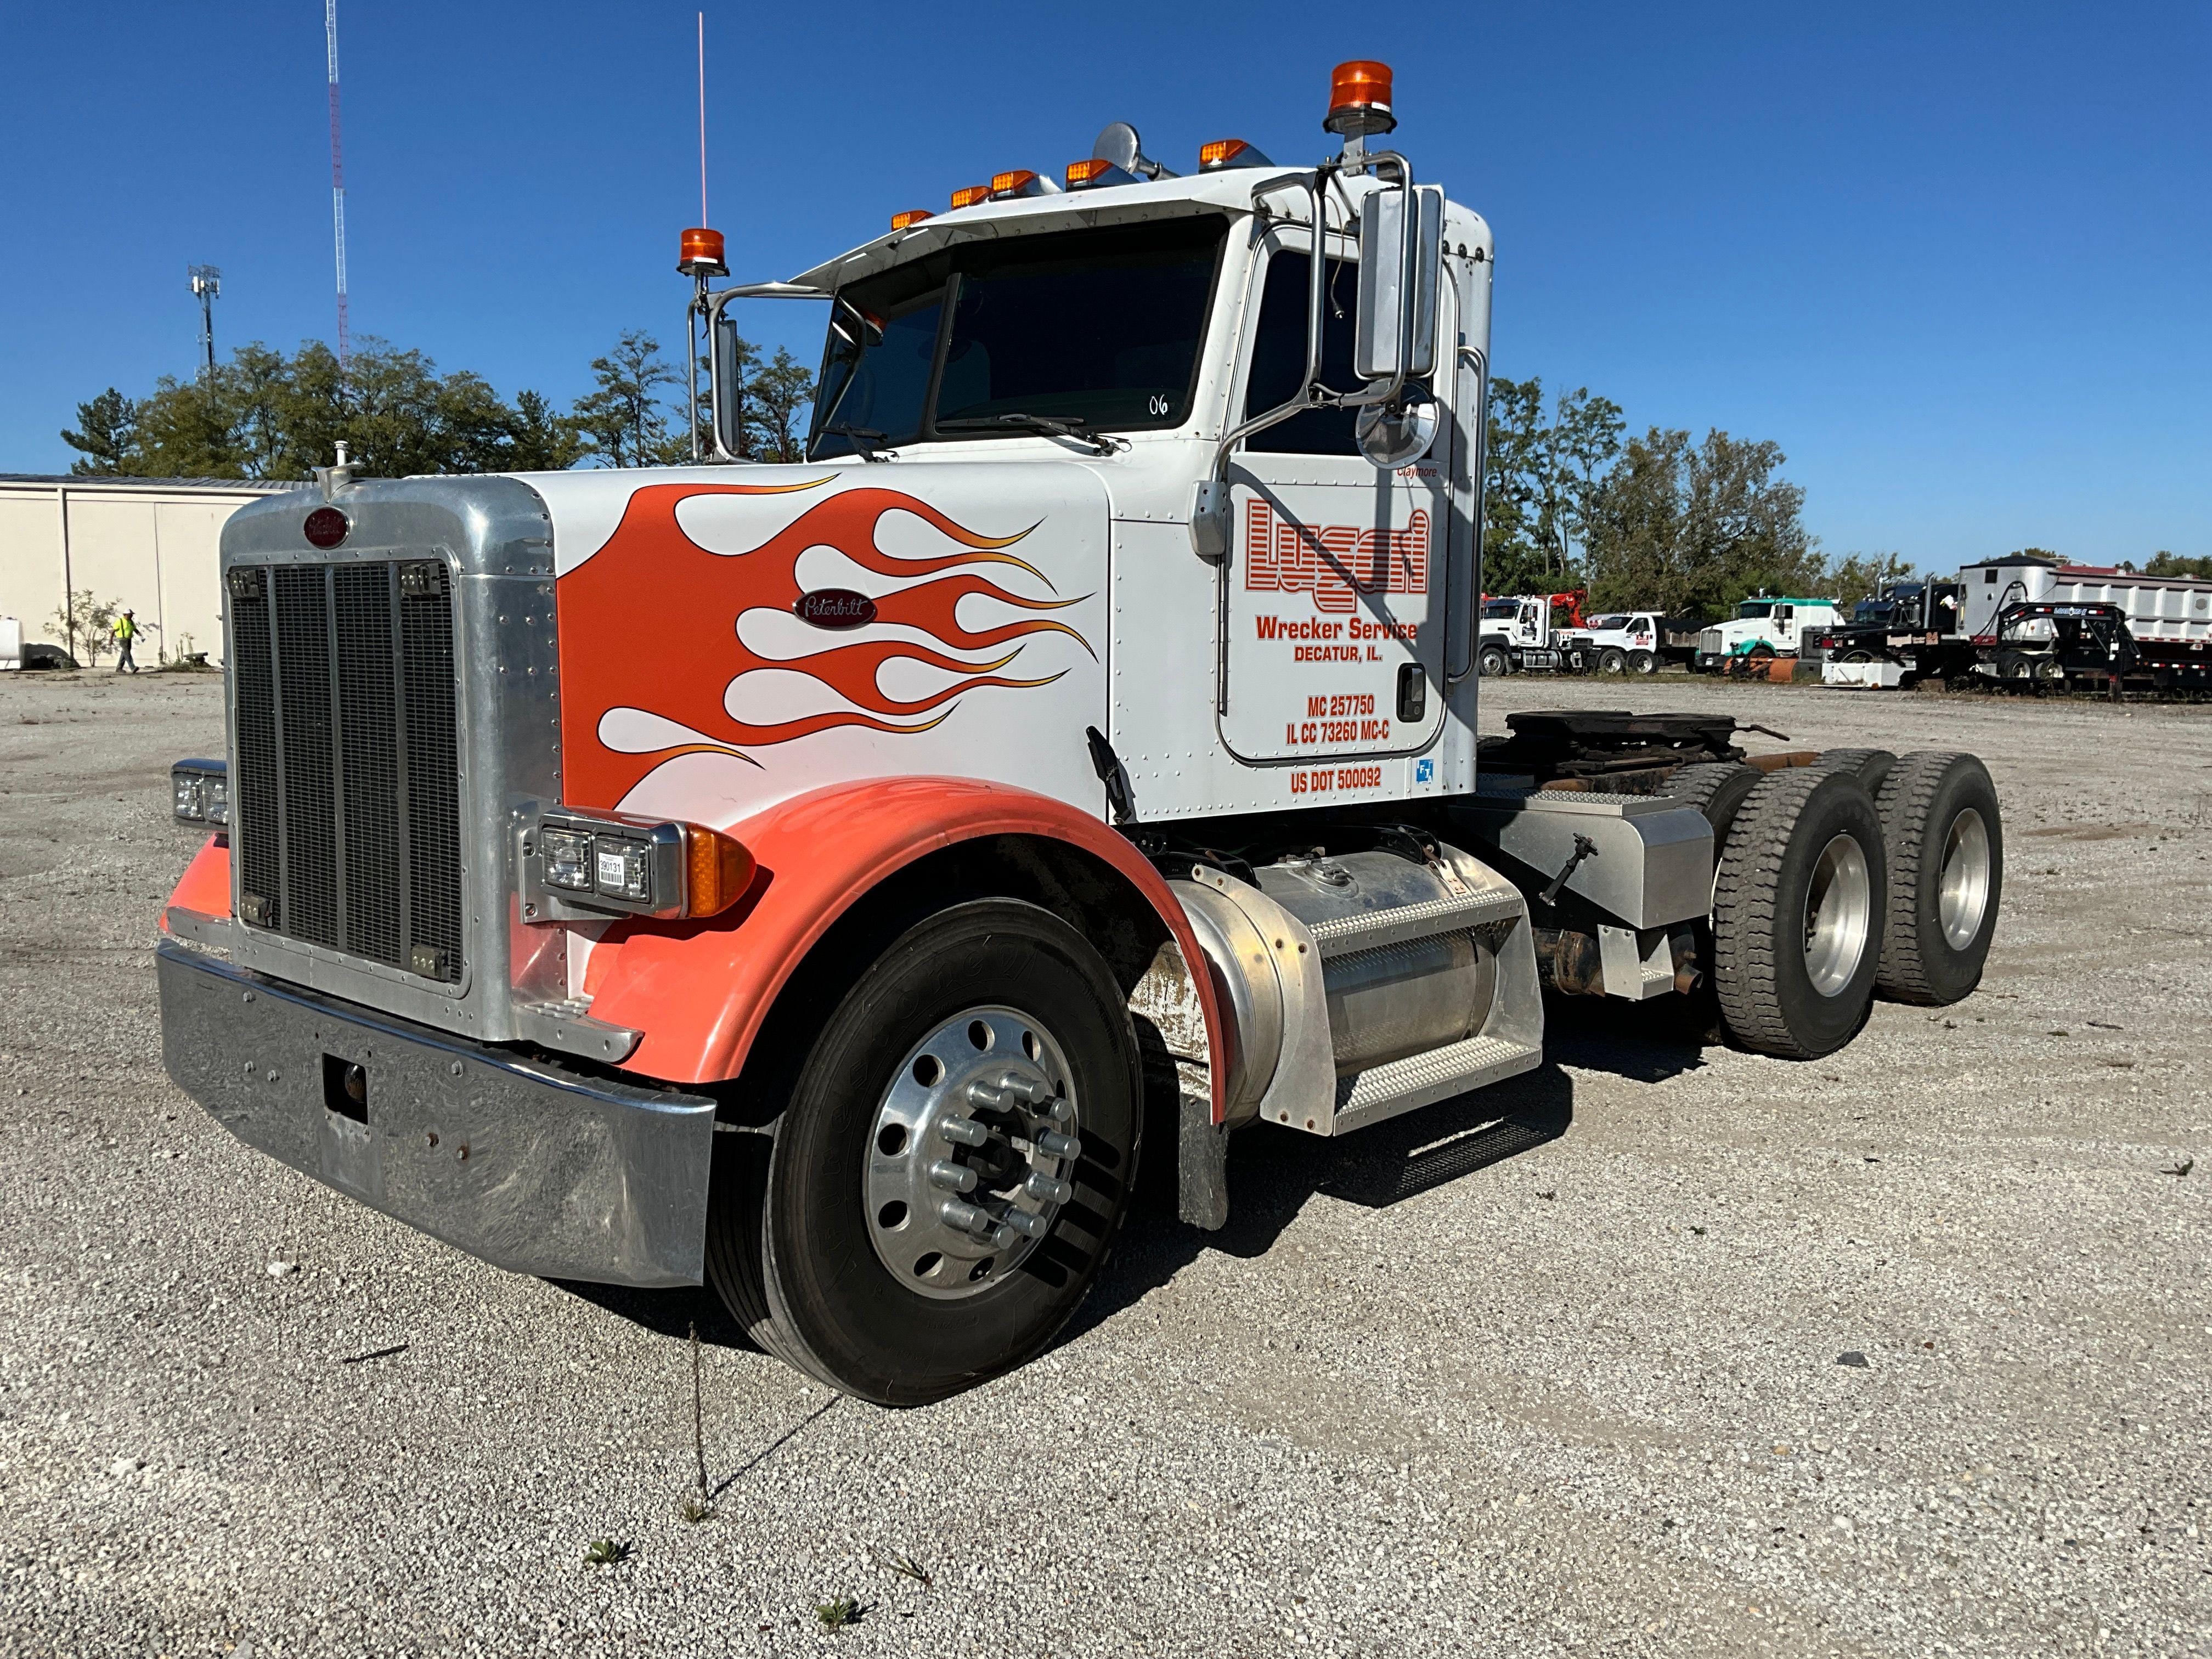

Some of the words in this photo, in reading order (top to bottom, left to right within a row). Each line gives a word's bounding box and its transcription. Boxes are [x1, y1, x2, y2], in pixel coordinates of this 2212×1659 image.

[1149, 394, 1168, 415] 06
[1397, 467, 1437, 479] Claymore
[804, 595, 868, 617] Peterbilt
[1255, 616, 1343, 640] Wrecker
[1348, 616, 1418, 640] Service
[1294, 646, 1362, 663] DECATUR,
[1367, 646, 1383, 661] IL.
[1307, 696, 1327, 718] MC
[1330, 693, 1374, 716] 257750
[1286, 724, 1298, 744] IL
[1301, 721, 1317, 744] CC
[1320, 720, 1357, 743] 73260
[1361, 719, 1389, 741] MC-C
[1290, 772, 1308, 793] US
[1311, 769, 1335, 792] DOT
[1338, 766, 1381, 790] 500092
